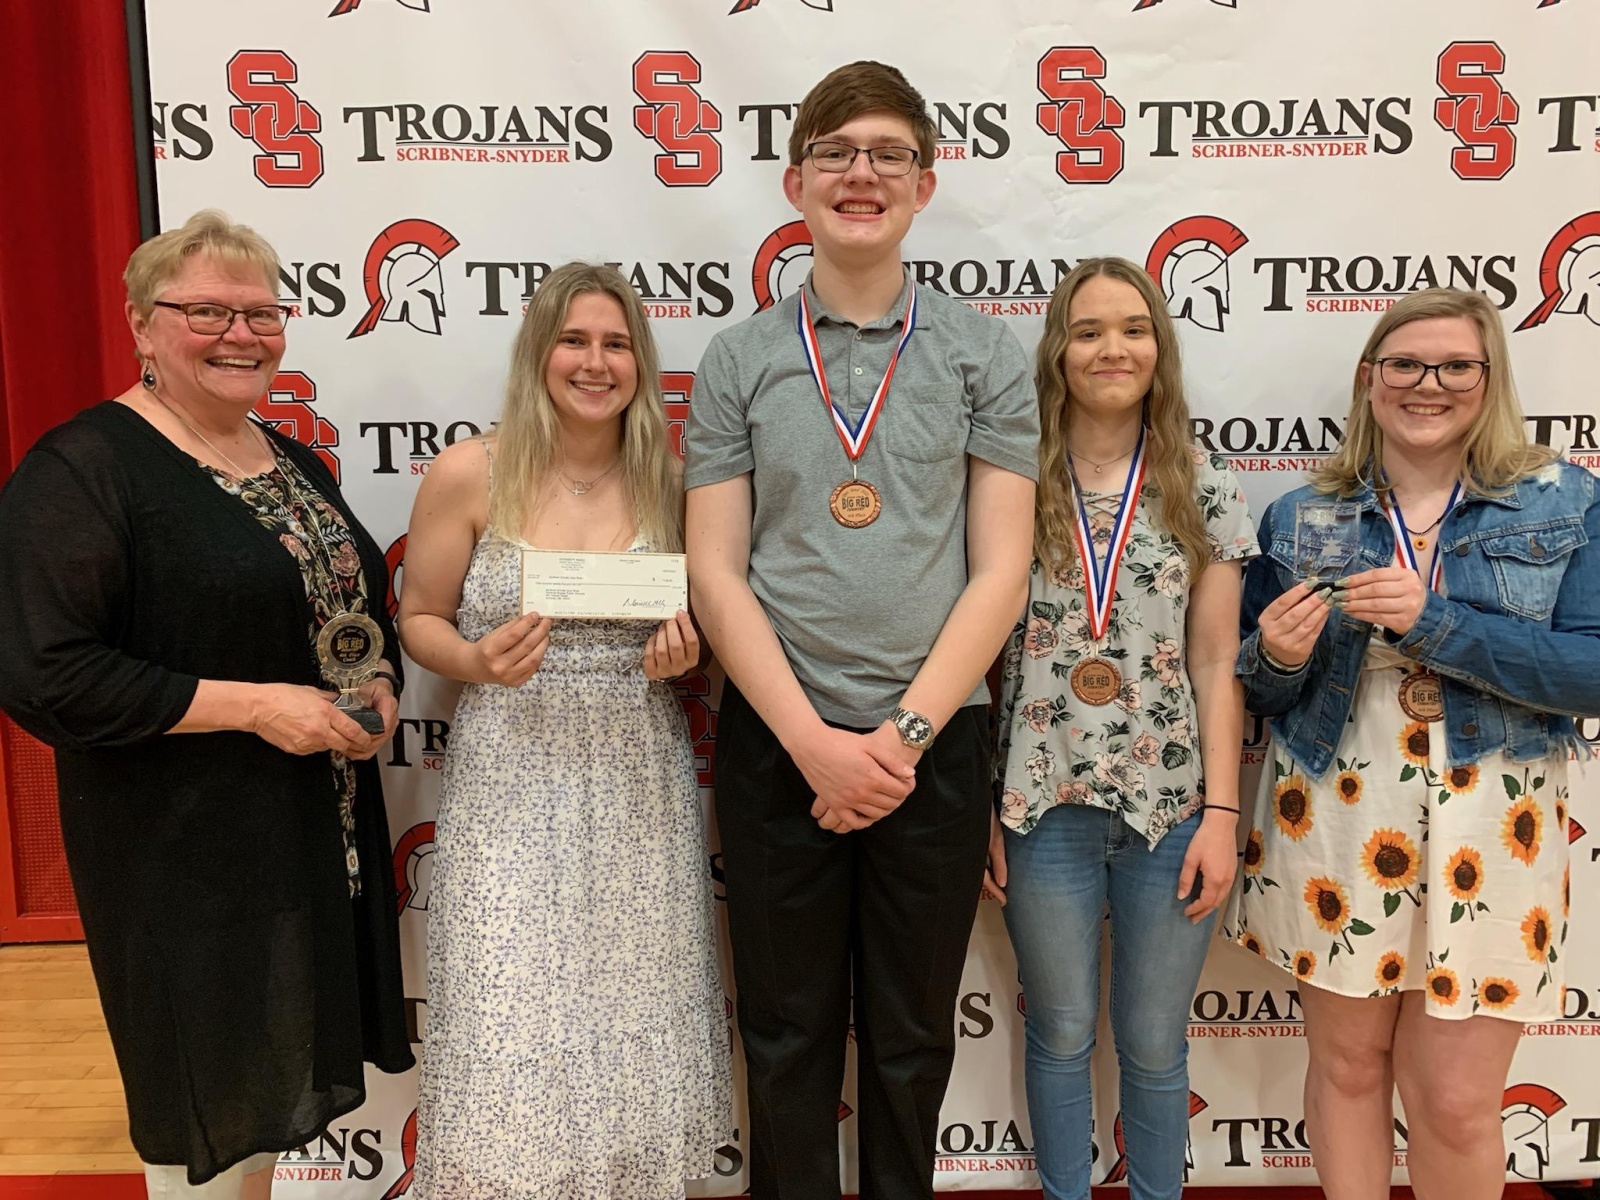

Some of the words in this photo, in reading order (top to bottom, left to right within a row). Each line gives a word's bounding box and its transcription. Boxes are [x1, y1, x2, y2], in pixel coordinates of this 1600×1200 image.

[343, 103, 613, 162] TROJANS
[1139, 97, 1413, 158] TROJANS
[396, 145, 571, 163] SCRIBNER-SNYDER
[1191, 141, 1368, 159] SCRIBNER-SNYDER
[465, 262, 734, 318] TRANS
[1253, 254, 1518, 312] TROJANS
[1306, 299, 1397, 313] SCRIBNER
[1190, 416, 1347, 453] ROJAN
[842, 497, 854, 510] BIG
[856, 497, 870, 508] RED
[1083, 675, 1095, 687] BIG
[1096, 675, 1110, 687] RED
[1412, 690, 1426, 703] BIG
